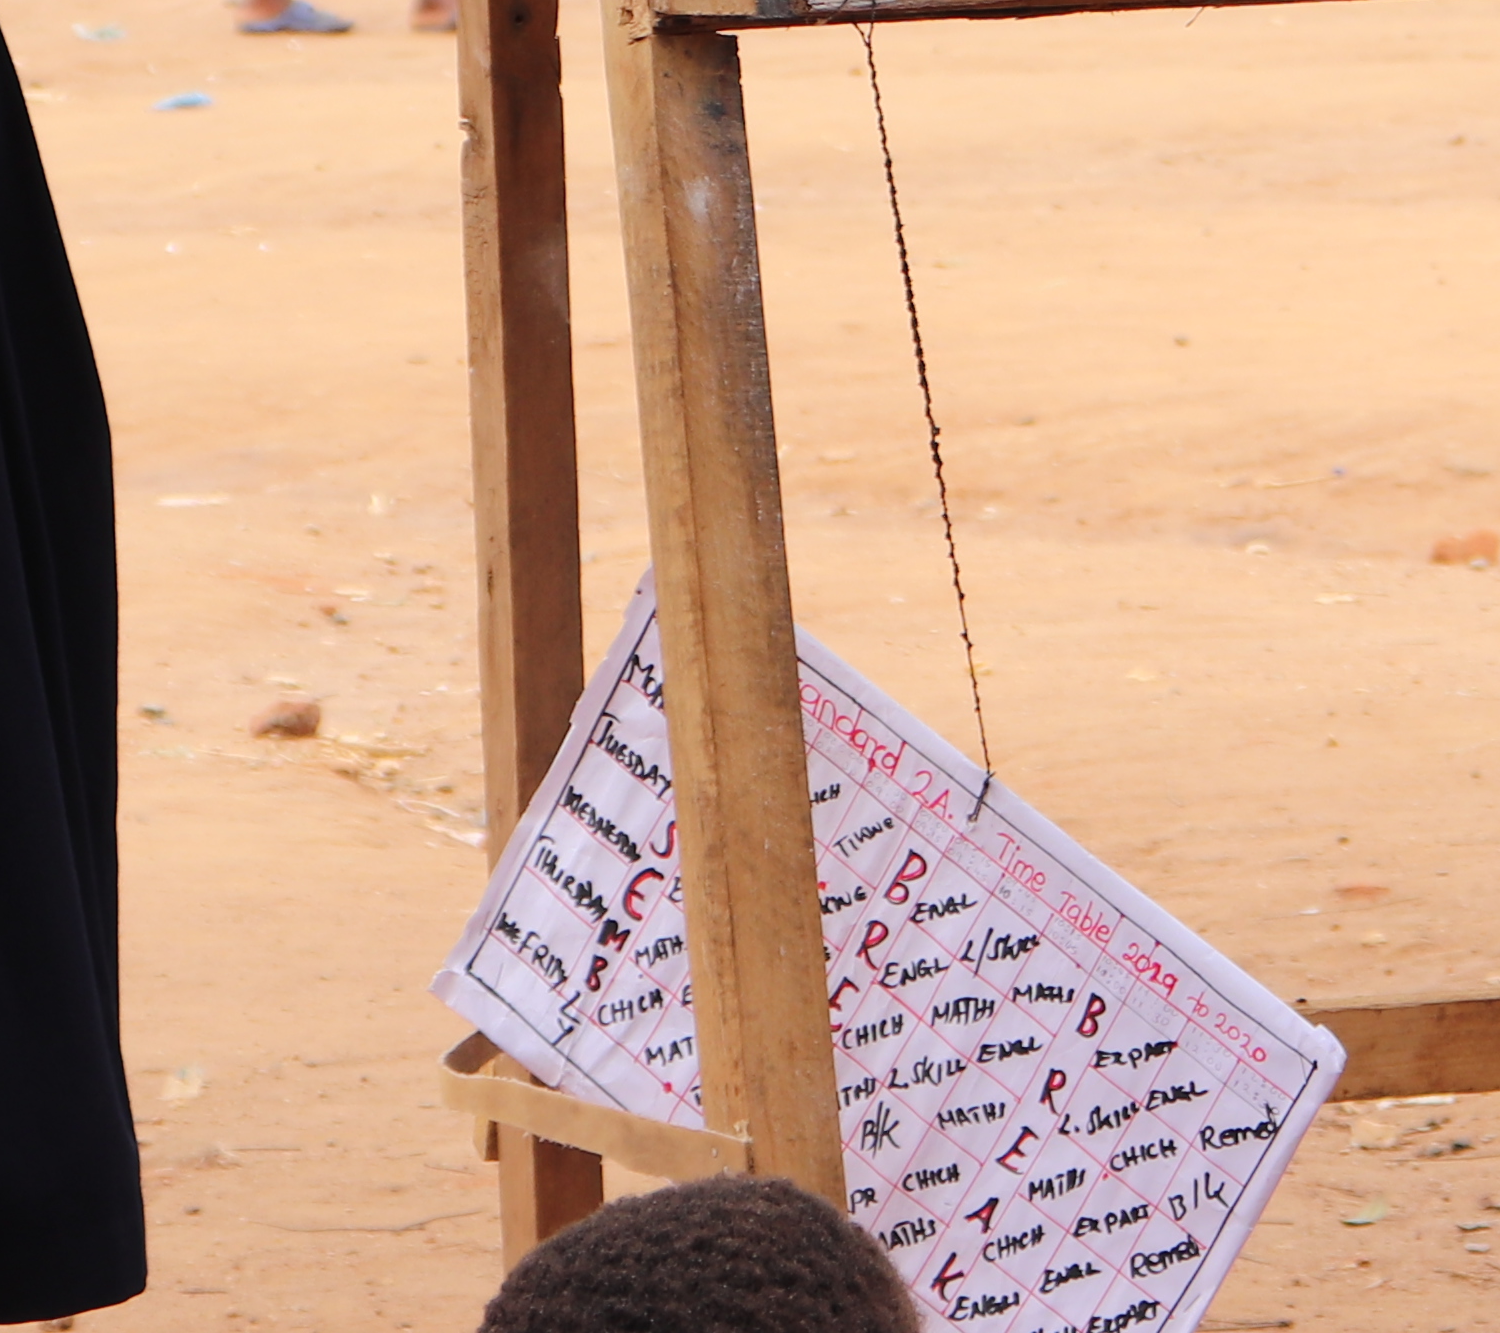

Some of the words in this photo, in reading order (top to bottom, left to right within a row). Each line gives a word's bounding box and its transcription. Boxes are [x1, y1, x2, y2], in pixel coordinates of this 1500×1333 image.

[798, 680, 908, 777] andard
[997, 833, 1046, 893] Time
[1060, 890, 1112, 944] Table
[1213, 1012, 1267, 1063] 2020
[878, 958, 950, 989] ENGL
